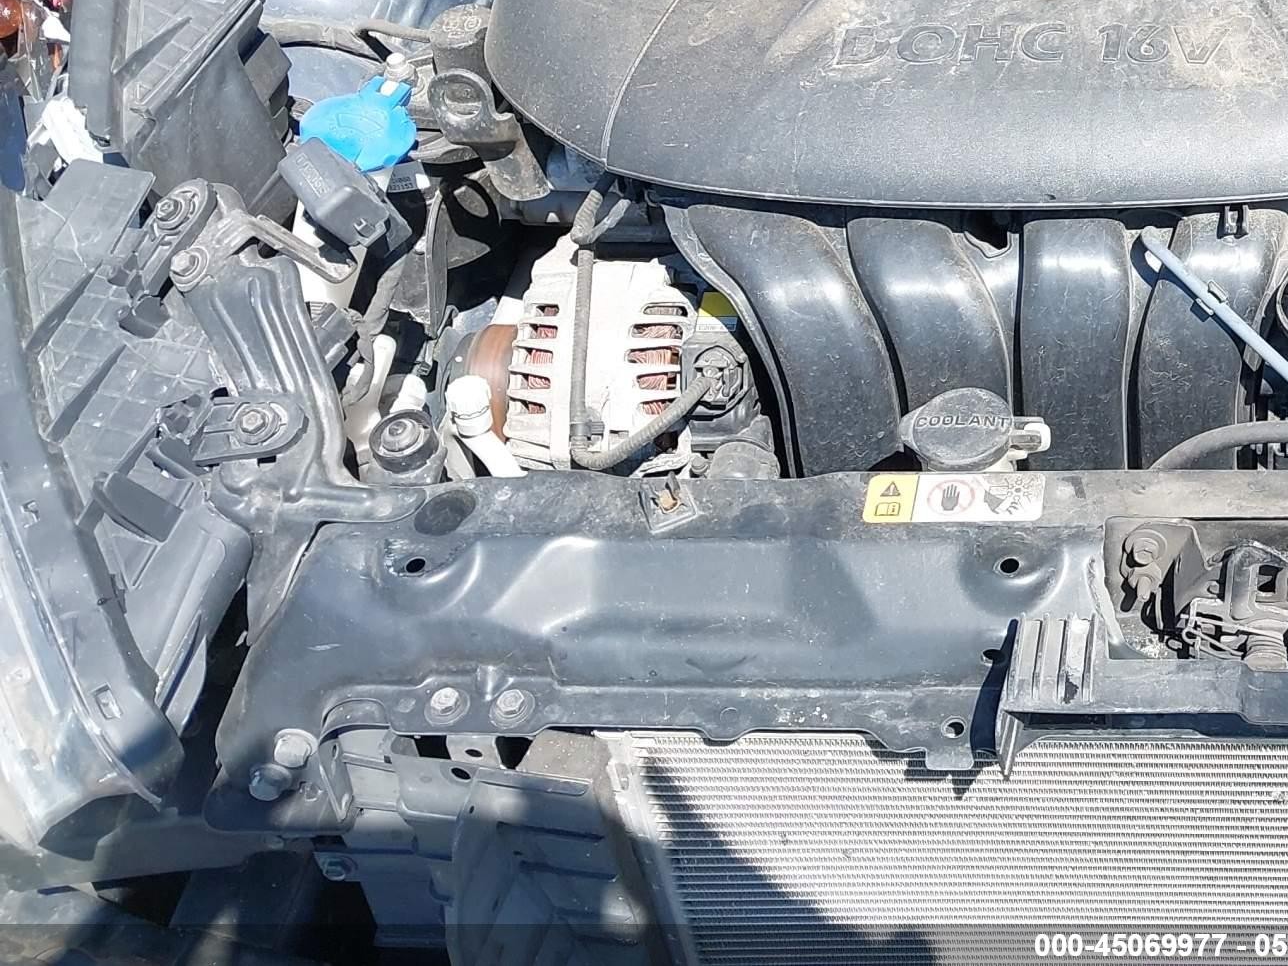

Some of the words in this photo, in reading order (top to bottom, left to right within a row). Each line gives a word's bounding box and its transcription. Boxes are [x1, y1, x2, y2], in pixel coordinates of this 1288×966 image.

[831, 22, 1067, 66] DOHC
[1098, 22, 1231, 65] 16V
[914, 414, 1010, 428] COOLANT
